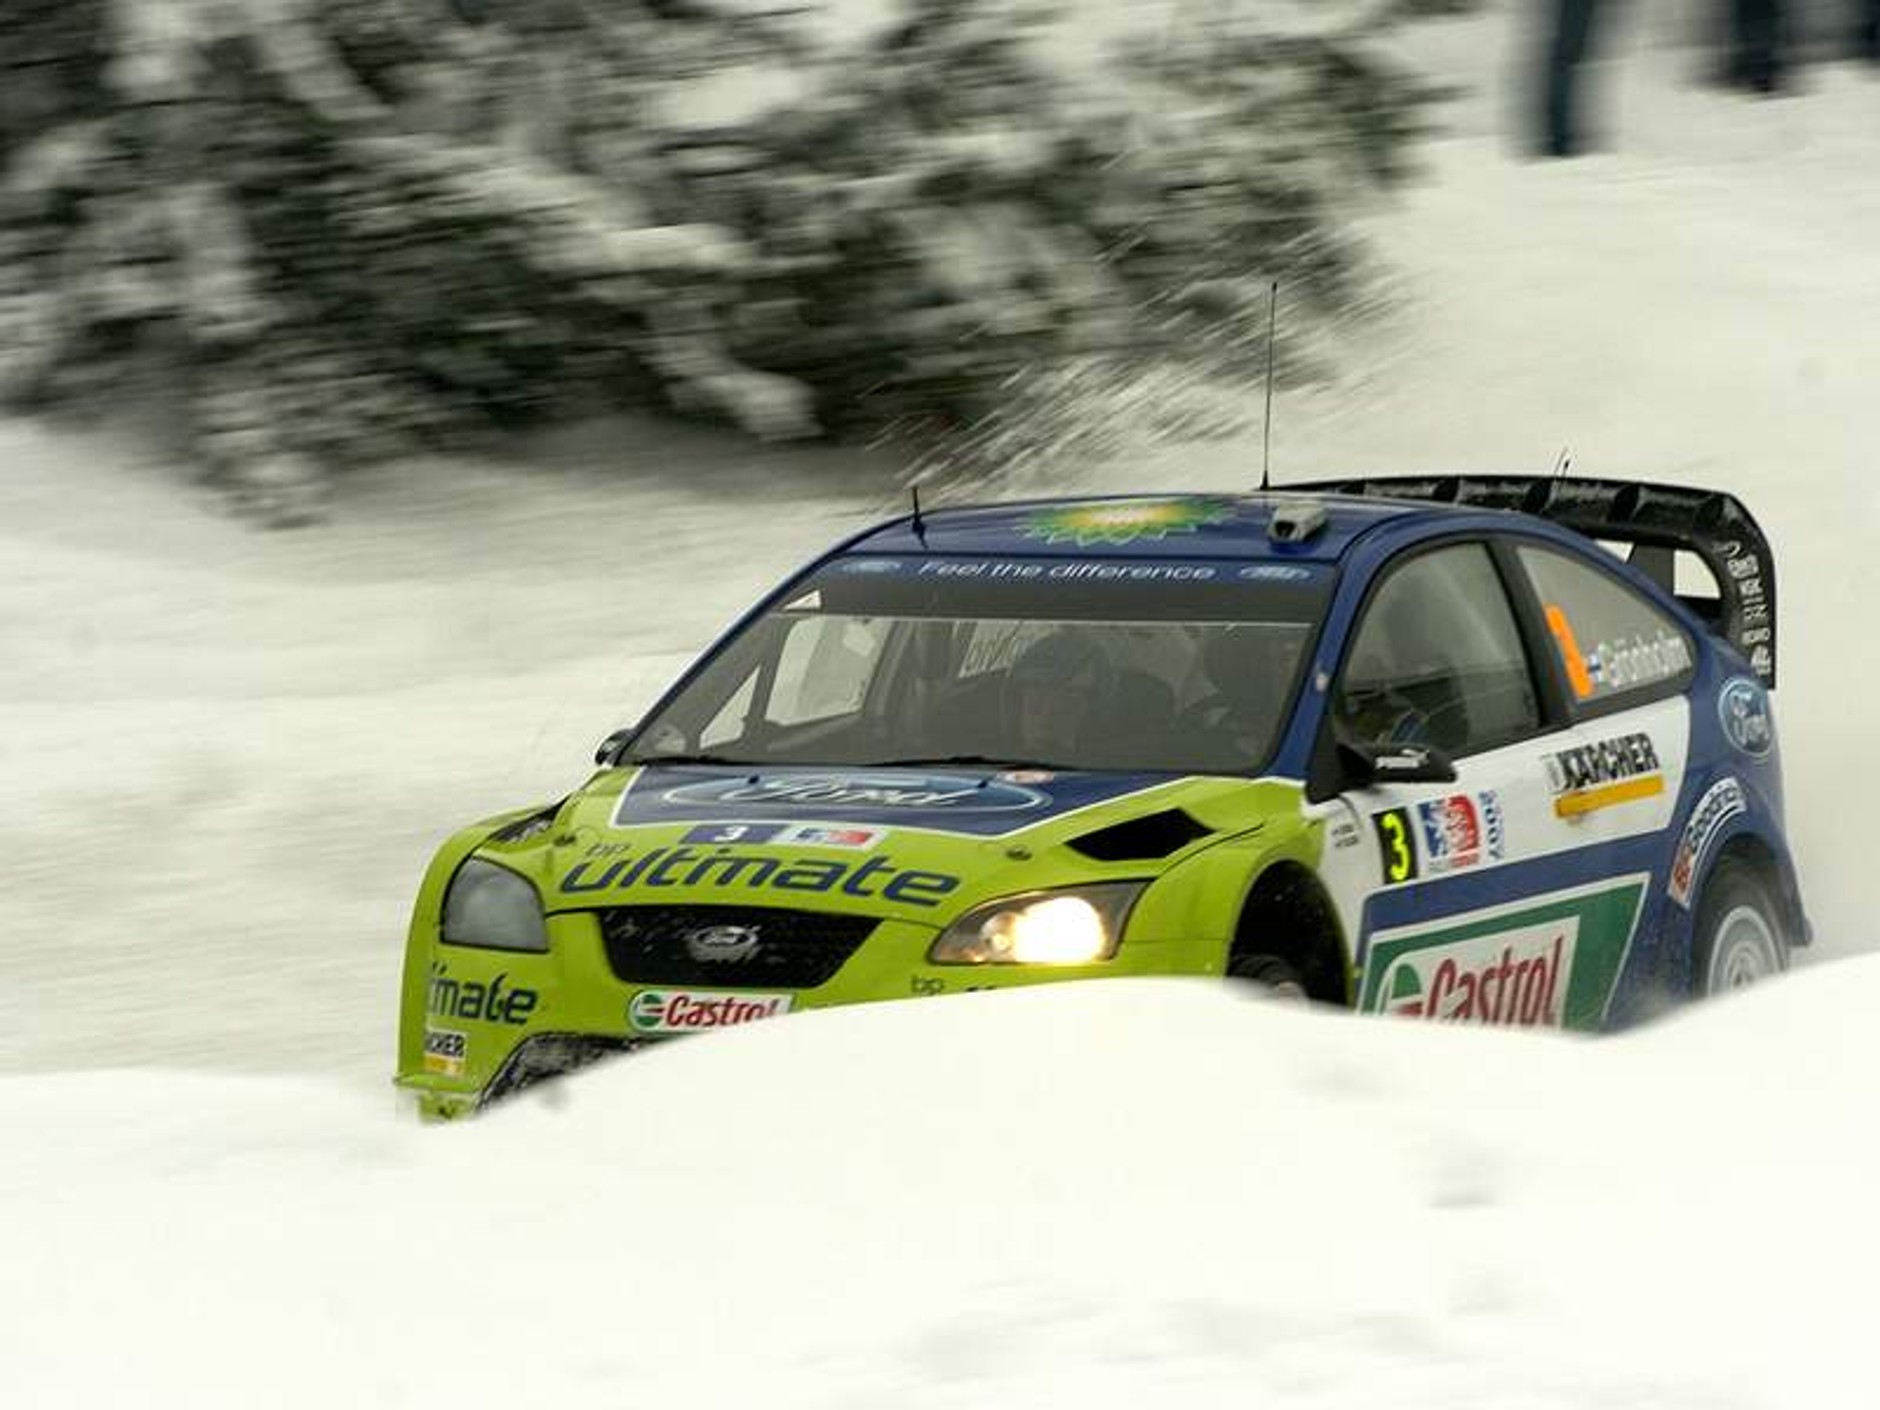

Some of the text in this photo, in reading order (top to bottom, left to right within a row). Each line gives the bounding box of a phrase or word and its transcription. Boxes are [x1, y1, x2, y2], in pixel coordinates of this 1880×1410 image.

[918, 561, 991, 576] Feel
[991, 562, 1043, 578] the
[1049, 563, 1216, 580] difference
[713, 825, 748, 842] 3
[1382, 812, 1411, 881] 3
[560, 846, 962, 907] ultimate
[910, 973, 945, 997] bp
[1425, 933, 1565, 1026] Castrol
[665, 993, 780, 1028] Castrol
